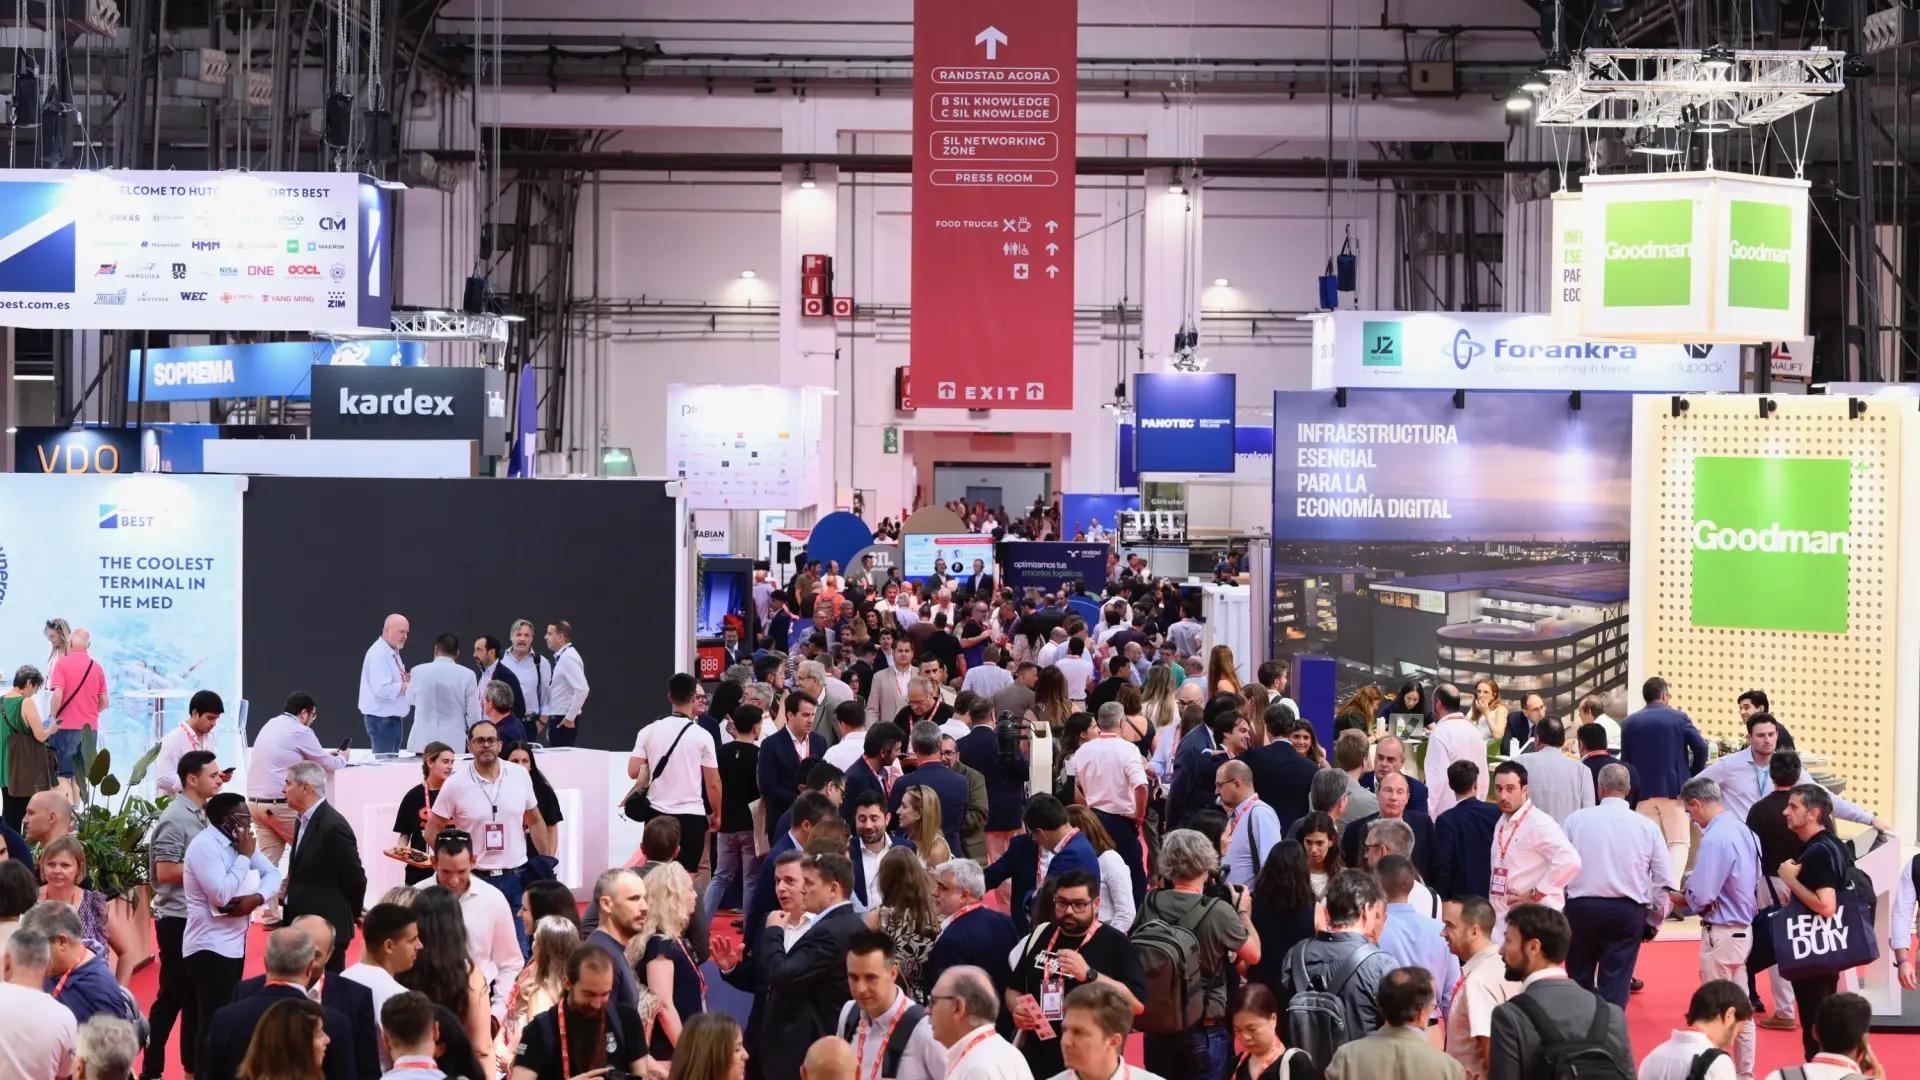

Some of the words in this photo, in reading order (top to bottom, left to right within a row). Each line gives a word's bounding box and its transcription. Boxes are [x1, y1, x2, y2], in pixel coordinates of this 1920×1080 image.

[940, 71, 1004, 80] RANDSTAD
[1008, 72, 1050, 81] AGORA
[942, 97, 950, 105] B
[953, 97, 971, 106] SIL
[974, 97, 1050, 107] KNOWLEDGE
[941, 109, 949, 117] C
[952, 109, 970, 118] SIL
[973, 110, 1049, 118] KNOWLEDGE
[943, 137, 960, 145] SIL
[964, 137, 1046, 146] NETWORKING
[943, 147, 976, 155] ZONE
[955, 173, 993, 182] PRESS
[997, 174, 1033, 183] ROOM
[170, 186, 186, 196] TO
[302, 188, 330, 198] BEST
[936, 220, 961, 228] FOOD
[963, 220, 998, 228] TRUCKS
[191, 241, 221, 251] HMM
[1605, 241, 1692, 260] Goodman
[1730, 240, 1791, 263] Goodman
[247, 266, 275, 276] ONE
[288, 264, 321, 275] OOCL
[180, 291, 208, 301] WEC
[270, 295, 292, 303] YANG
[293, 295, 315, 303] MING
[327, 300, 346, 309] ZIM
[1494, 338, 1637, 359] forankra
[153, 360, 235, 386] SOPREMA
[965, 386, 1019, 401] EXIT
[339, 387, 454, 416] kardex
[1141, 418, 1195, 429] PANOTEC
[1298, 424, 1458, 444] INFRAESTRUCTURA
[37, 444, 120, 474] VDO
[1298, 448, 1376, 468] ESENCIAL
[1297, 473, 1341, 493] PARA
[1345, 474, 1367, 493] LA
[1150, 498, 1185, 506] Circular
[1297, 494, 1384, 518] ECONOMÍA
[1388, 499, 1452, 519] DIGITAL
[121, 516, 154, 527] BEST
[1693, 519, 1850, 554] Goodman
[100, 557, 132, 569] THE
[136, 557, 214, 571] COOLEST
[1013, 561, 1056, 569] optimizamos
[1056, 561, 1067, 569] tus
[100, 577, 184, 590] TERMINAL
[188, 578, 206, 590] IN
[100, 596, 132, 608] THE
[136, 597, 173, 609] MED
[701, 659, 719, 671] 888
[1786, 904, 1845, 940] HEAVY
[1792, 925, 1849, 960] DUTY
